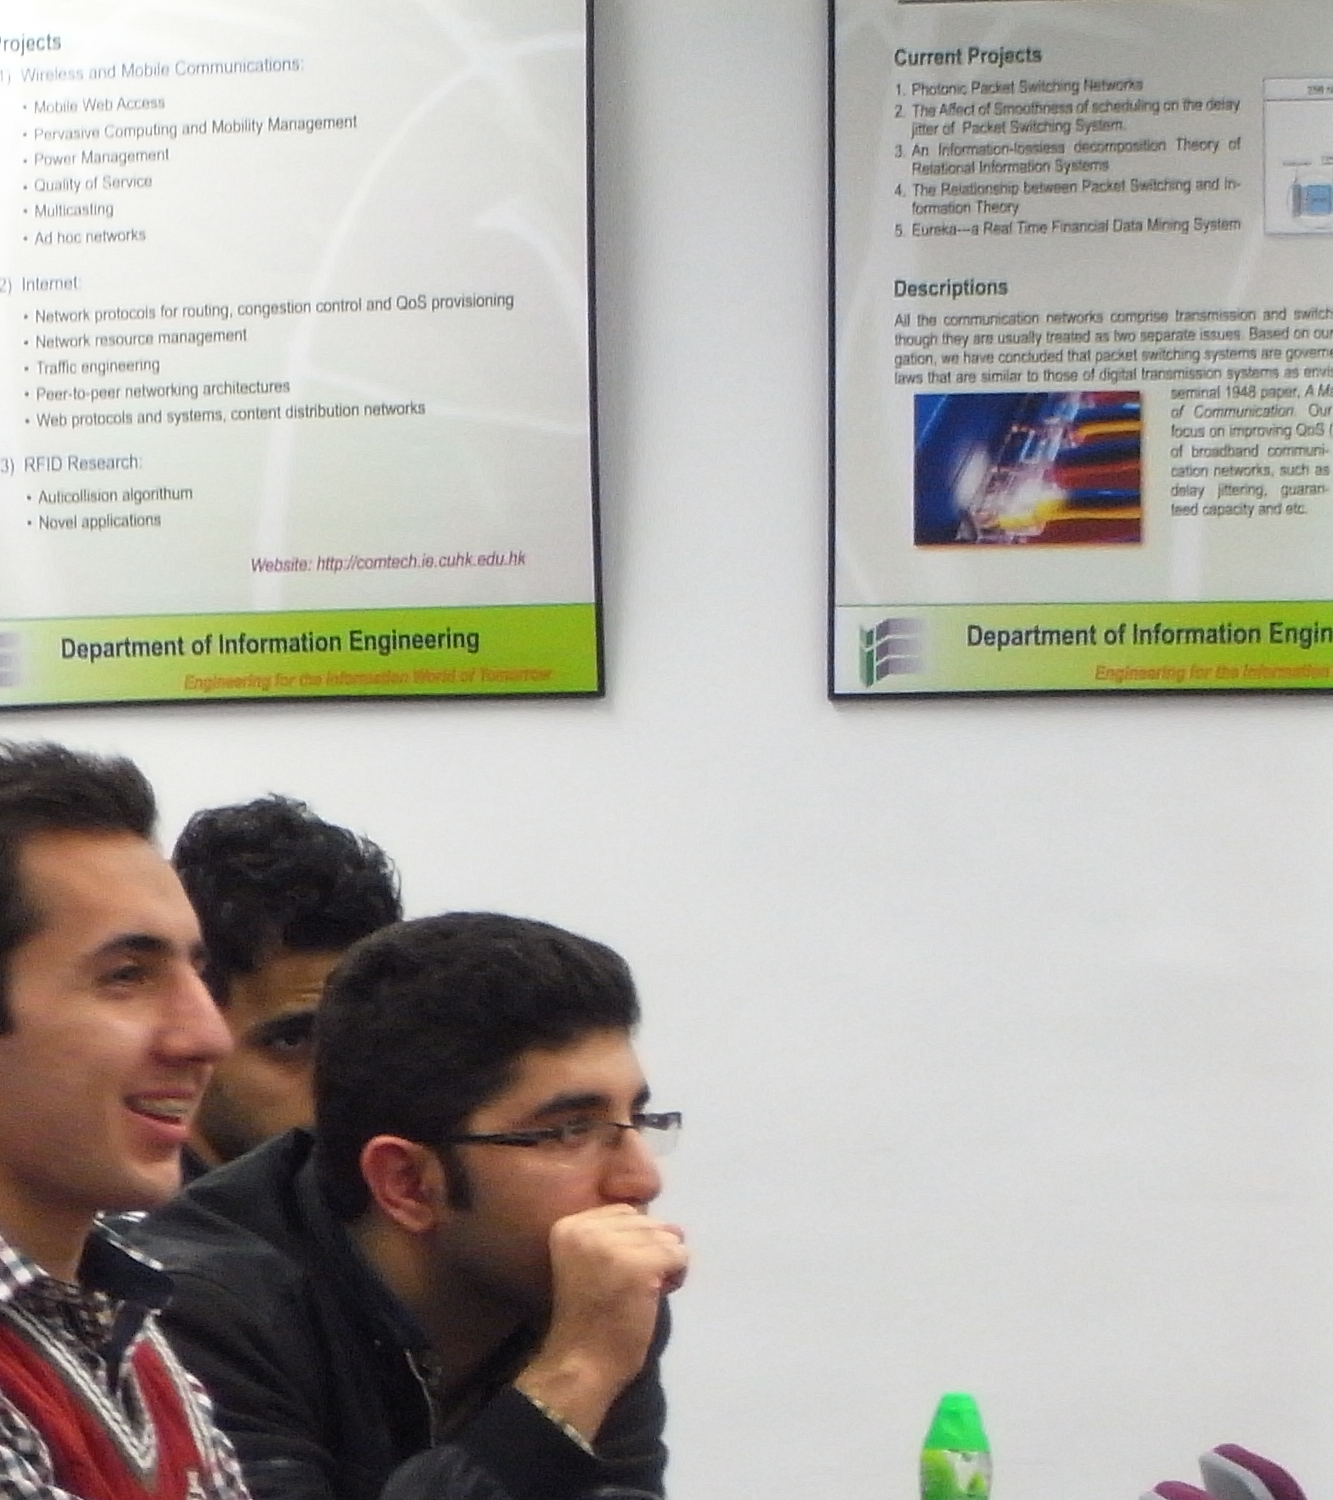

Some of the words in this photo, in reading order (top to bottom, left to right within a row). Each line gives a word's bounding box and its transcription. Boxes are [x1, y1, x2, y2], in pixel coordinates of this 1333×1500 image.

[893, 48, 962, 65] Current
[967, 46, 1042, 67] Projects
[21, 67, 84, 82] Wireless
[88, 66, 116, 79] and
[120, 62, 170, 77] Mobile
[174, 59, 303, 75] Communications:
[911, 82, 967, 96] Photonic
[970, 80, 1015, 95] Packet
[1018, 78, 1080, 97] Switching
[1082, 78, 1144, 92] Networks
[33, 100, 78, 113] Mobile
[82, 98, 113, 111] Web
[116, 97, 165, 110] Access
[913, 103, 936, 118] The
[977, 102, 991, 116] of
[1075, 99, 1088, 113] of
[1090, 99, 1160, 115] scheduling
[1162, 101, 1179, 111] on
[1181, 98, 1203, 111] the
[1204, 99, 1240, 112] delay
[33, 128, 100, 141] Pervasive
[103, 124, 177, 141] Computing
[181, 122, 207, 135] and
[211, 119, 263, 135] Mobility
[267, 115, 357, 133] Management
[911, 123, 938, 140] jitter
[941, 121, 955, 135] of
[961, 120, 1006, 134] Packet
[1009, 119, 1072, 136] Switching
[33, 152, 75, 166] Power
[80, 149, 169, 165] Management
[911, 162, 975, 175] Relational
[978, 160, 1051, 174] Information
[1054, 158, 1109, 175] Systems
[33, 178, 81, 194] Quality
[84, 177, 98, 190] of
[102, 176, 152, 188] Service
[34, 203, 114, 219] Multicasting
[34, 231, 53, 245] Ad
[56, 232, 81, 244] hoc
[85, 230, 146, 243] networks
[893, 279, 1008, 300] Descriptions
[34, 309, 89, 323] Network
[94, 308, 156, 322] protocols
[159, 304, 177, 318] for
[181, 305, 233, 322] routing,
[236, 302, 311, 317] congestion
[315, 299, 362, 312] control
[365, 297, 392, 311] and
[395, 295, 427, 310] QoS
[430, 295, 514, 313] provisioning
[35, 334, 90, 348] Network
[94, 335, 154, 346] resource
[157, 330, 247, 345] management
[38, 360, 77, 374] Traffic
[80, 361, 160, 376] engineering
[35, 386, 120, 402] Peer-to-peer
[124, 385, 199, 400] networking
[202, 381, 290, 395] architectures
[36, 413, 67, 427] Web
[70, 413, 133, 428] protocols
[136, 411, 162, 424] and
[166, 410, 226, 424] systems,
[230, 407, 281, 421] content
[284, 404, 359, 418] distribution
[363, 403, 426, 416] networks
[1169, 444, 1183, 458] of
[1190, 444, 1259, 458] broadband
[23, 456, 62, 472] RFID
[1170, 466, 1209, 477] cation
[1278, 464, 1310, 476] such
[1314, 465, 1330, 475] as
[1170, 503, 1199, 516] teed
[1201, 504, 1254, 518] capacity
[1257, 503, 1283, 515] and
[38, 515, 77, 529] Novel
[81, 514, 161, 530] applications
[315, 551, 526, 572] http://comtech.ie.cuhk.edu.hk
[966, 625, 1096, 650] Department
[1103, 623, 1125, 645] of
[1132, 623, 1261, 645] Information
[1268, 622, 1333, 648] Engin
[60, 637, 184, 663] Department
[191, 634, 211, 655] of
[218, 632, 341, 654] Information
[349, 633, 479, 657] Engineering
[183, 674, 273, 694] Engineering
[273, 673, 297, 688] for
[298, 672, 324, 687] the
[324, 670, 412, 686] Information
[410, 669, 456, 684] World
[456, 667, 476, 683] of
